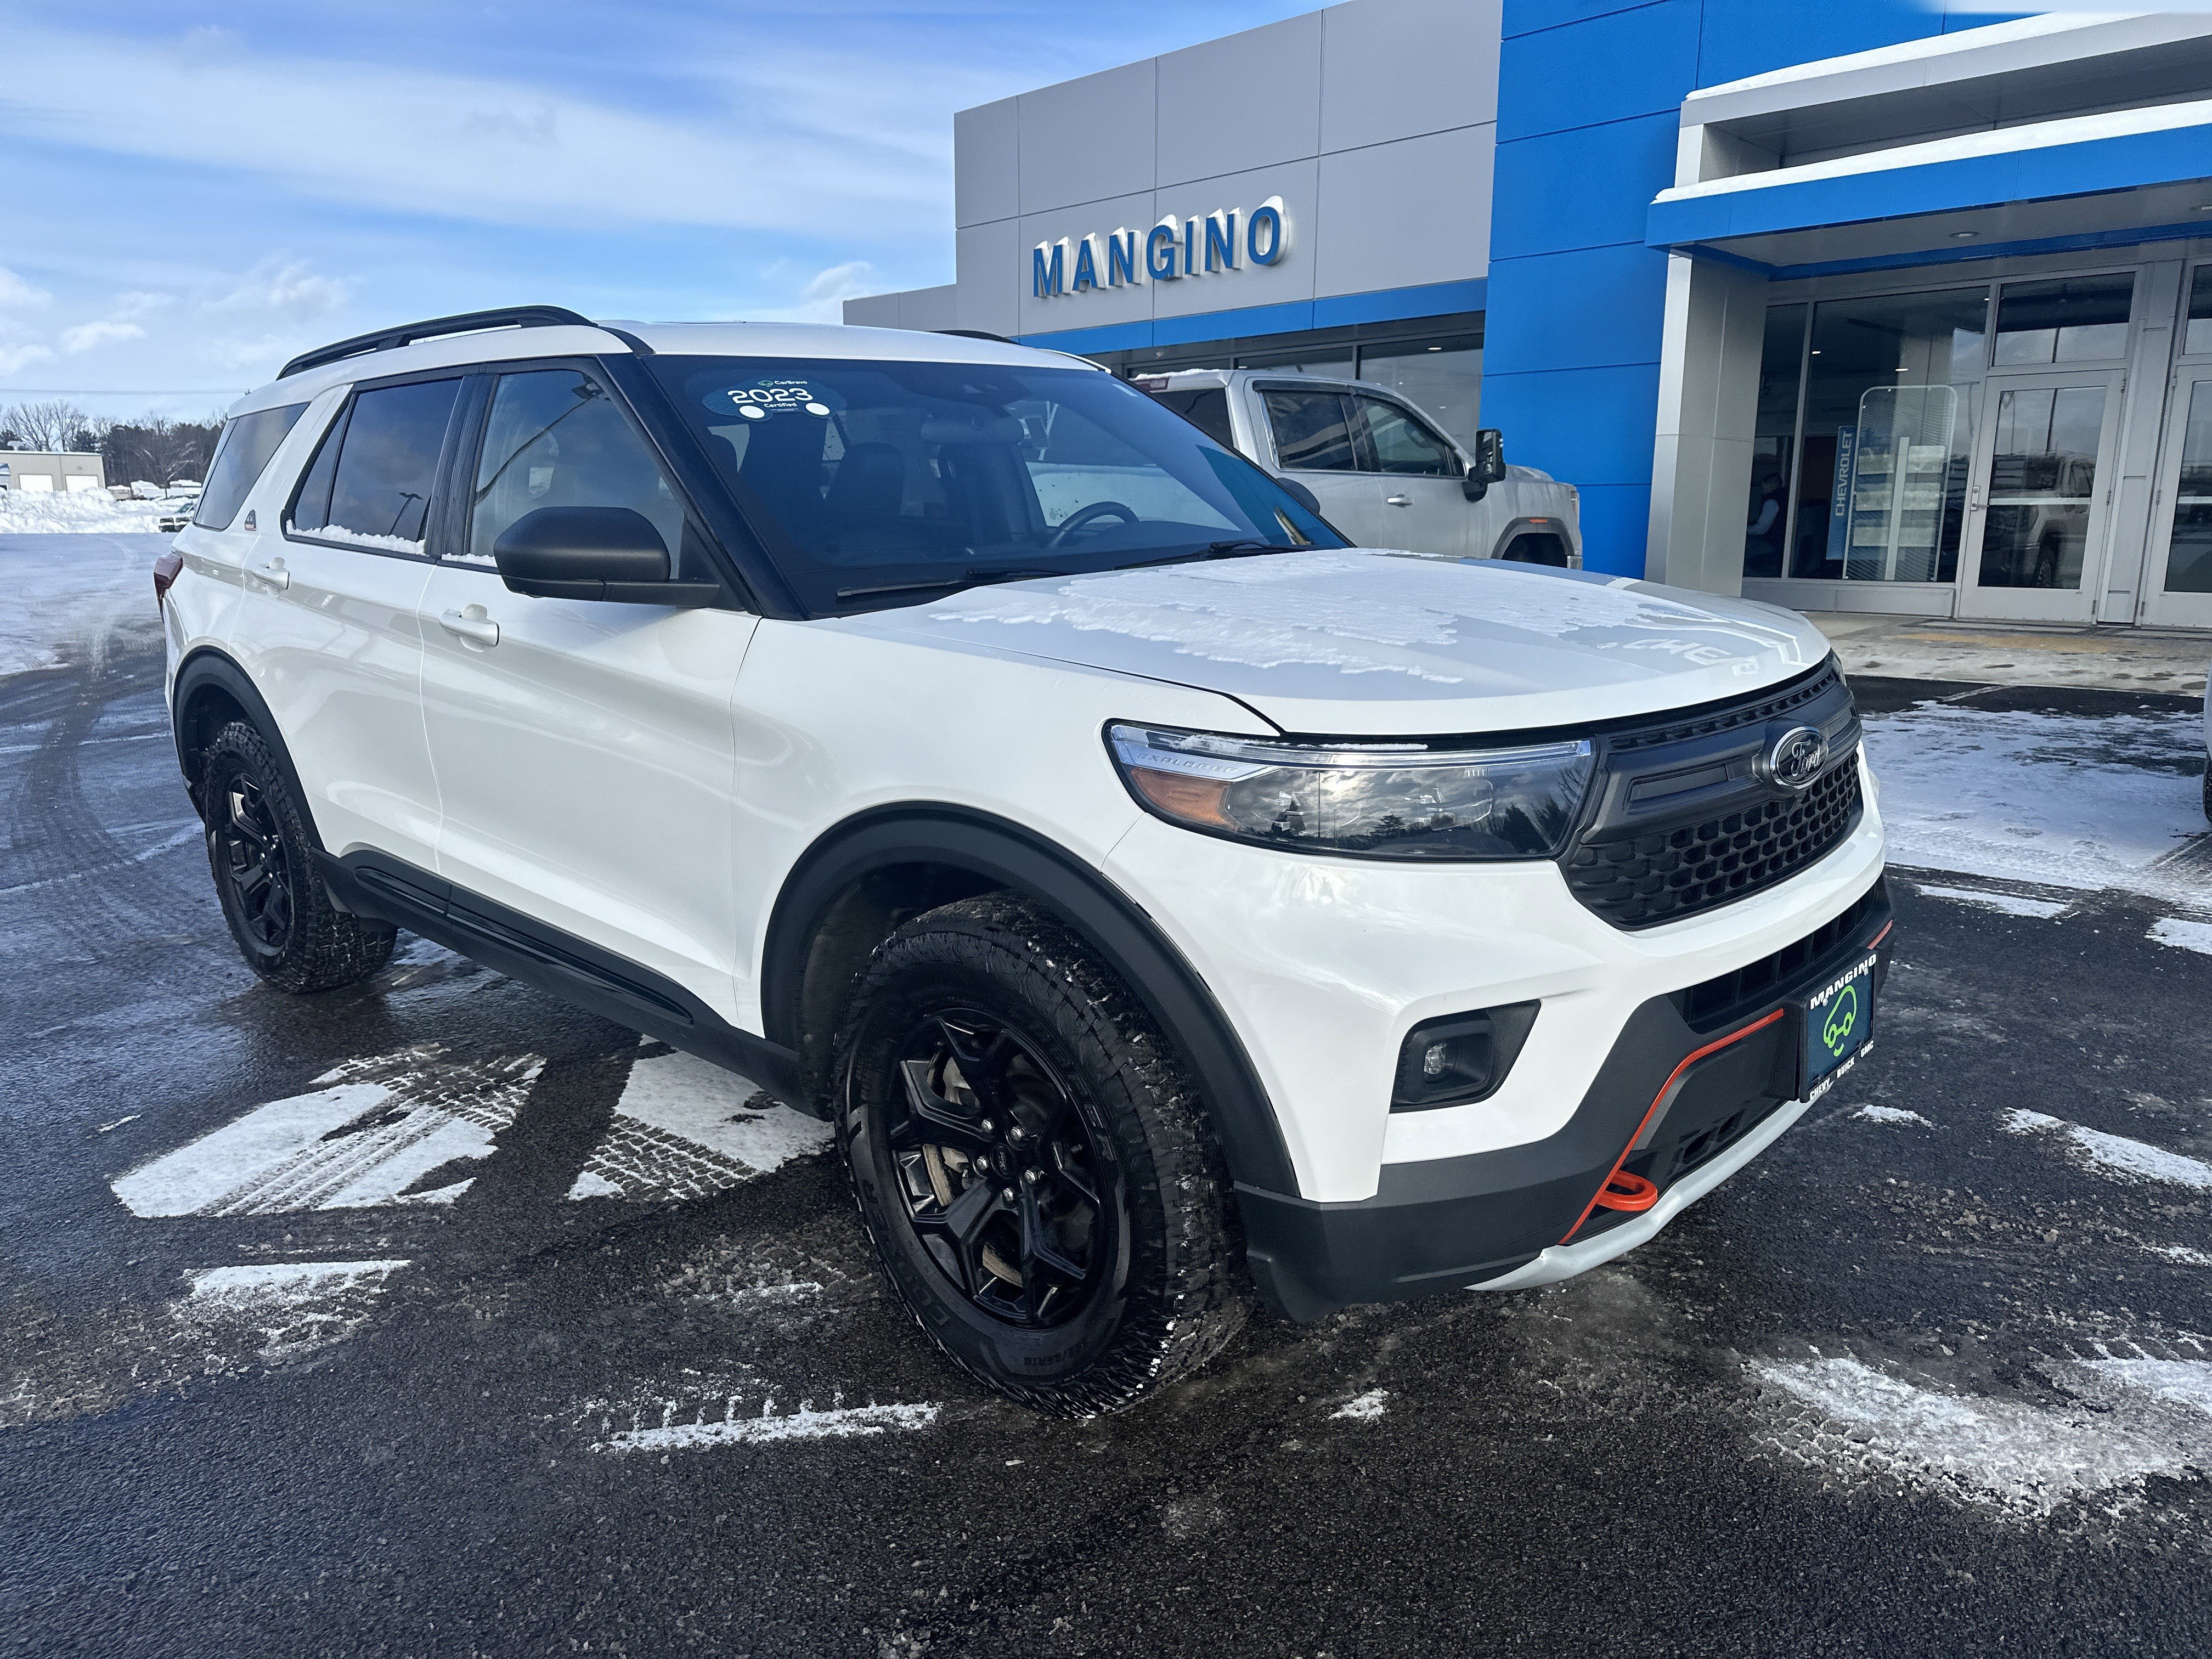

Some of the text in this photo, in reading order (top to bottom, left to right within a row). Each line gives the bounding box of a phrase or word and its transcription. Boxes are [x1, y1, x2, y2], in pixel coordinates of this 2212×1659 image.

[1033, 205, 1285, 297] MANGINO
[727, 388, 813, 404] 2023
[1835, 430, 1853, 517] CHEVROLET
[1791, 738, 1821, 777] Ford
[1810, 953, 1877, 1010] MANGINO
[1809, 1040, 1874, 1101] CHEVY BUICK GMC
